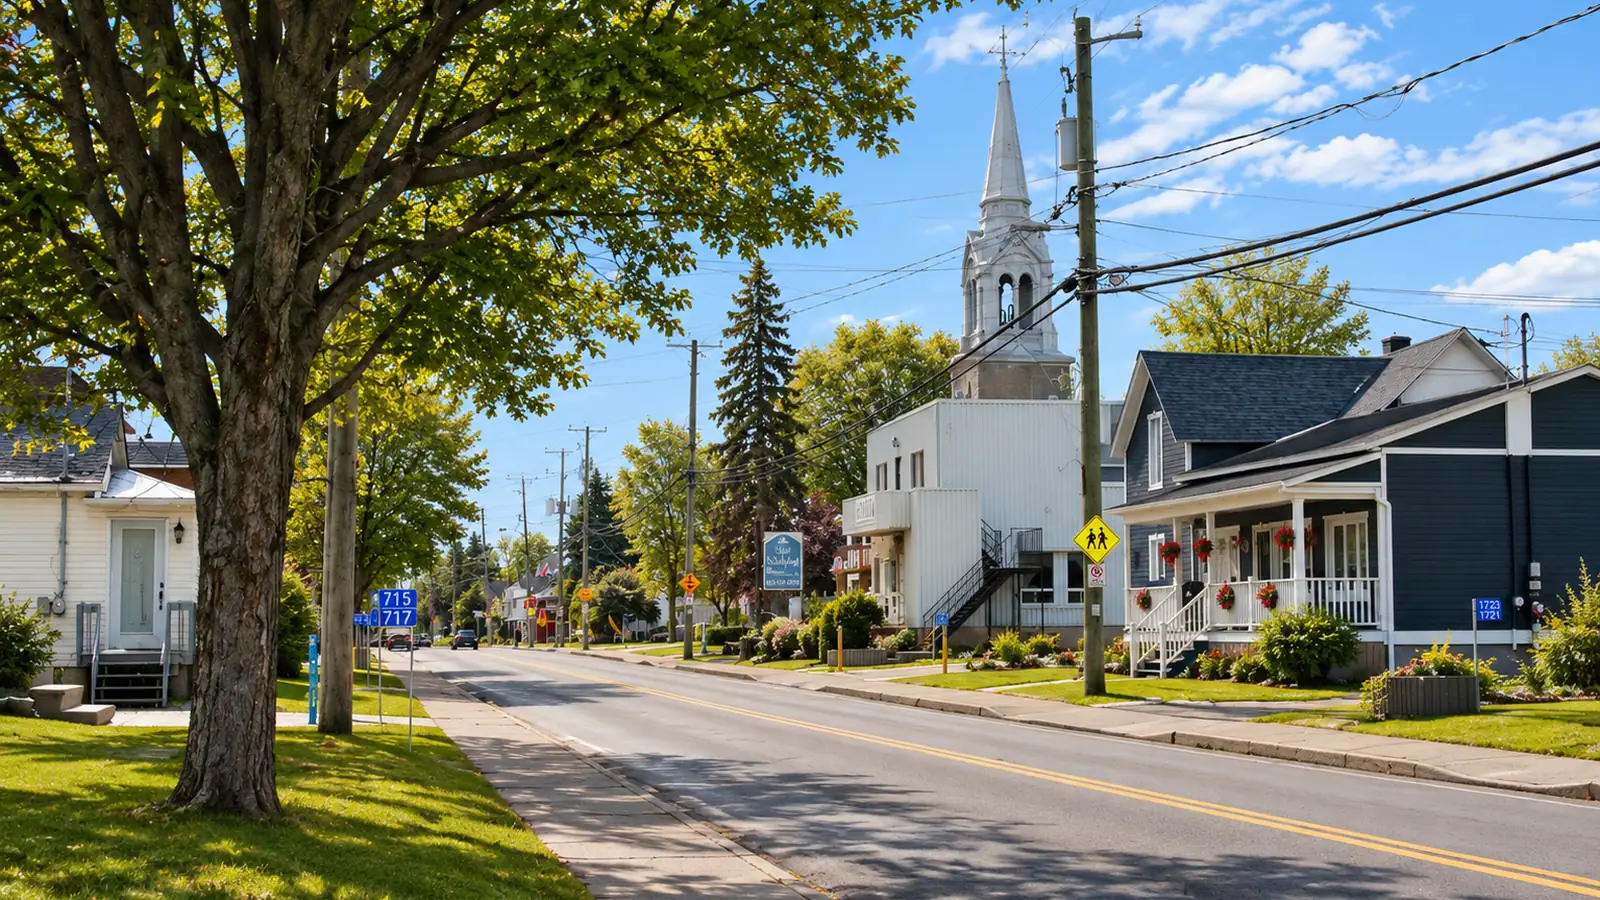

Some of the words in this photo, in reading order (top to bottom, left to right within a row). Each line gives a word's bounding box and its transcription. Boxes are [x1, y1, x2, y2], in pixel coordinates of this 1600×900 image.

[383, 591, 411, 606] 715
[1479, 600, 1500, 610] 1723
[383, 610, 412, 625] 717
[1480, 610, 1500, 620] 1721
